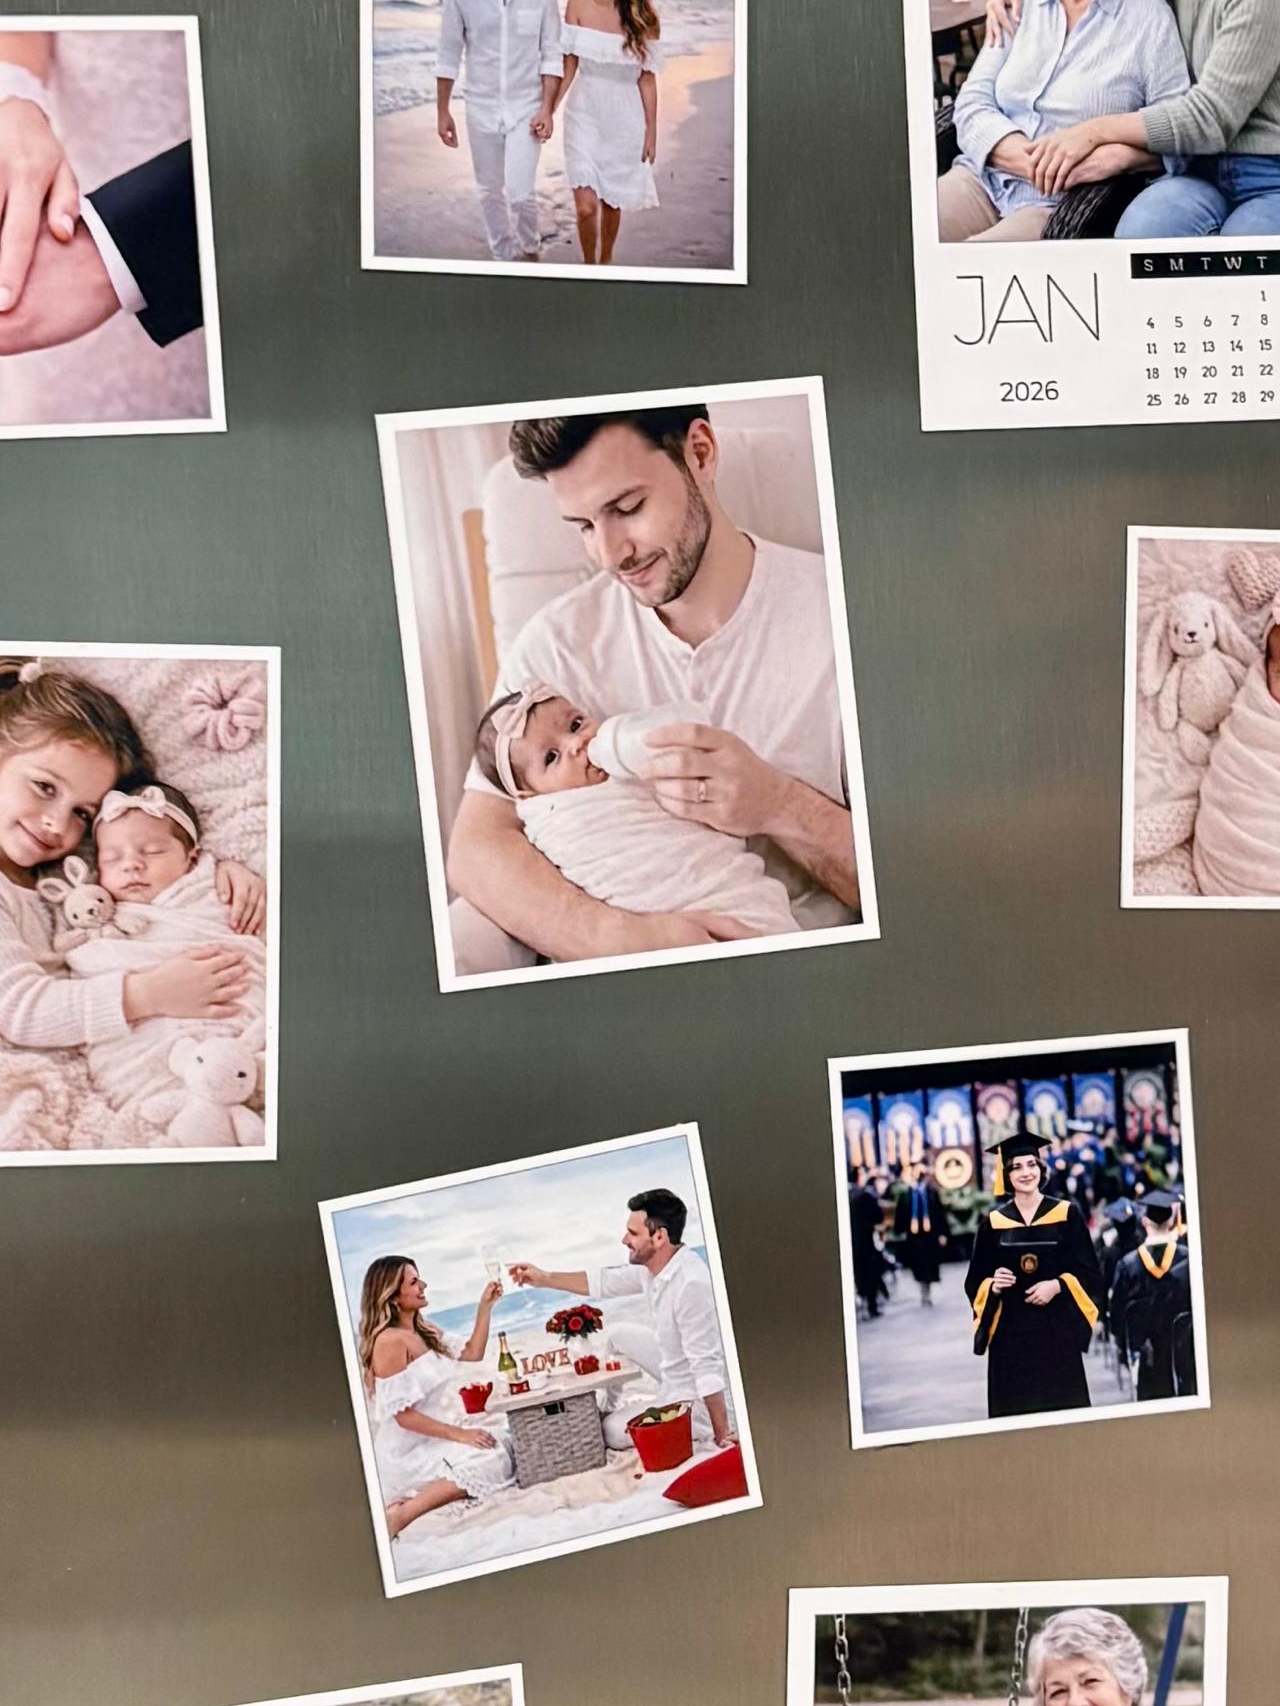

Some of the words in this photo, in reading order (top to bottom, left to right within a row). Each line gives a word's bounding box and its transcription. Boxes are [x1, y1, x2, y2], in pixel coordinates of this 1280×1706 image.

[1143, 258, 1154, 272] S
[1169, 257, 1184, 271] M
[1200, 257, 1212, 270] T
[1223, 256, 1242, 270] W
[1256, 255, 1268, 269] T
[1260, 290, 1267, 302] 1
[954, 272, 1100, 346] JAN
[1146, 317, 1155, 329] 4
[1174, 315, 1184, 329] 5
[1203, 315, 1213, 328] 6
[1230, 314, 1240, 327] 7
[1260, 313, 1269, 326] 8
[1146, 342, 1158, 355] 11
[1173, 341, 1186, 354] 12
[1202, 340, 1216, 353] 13
[1230, 339, 1243, 352] 14
[1259, 338, 1273, 351] 15
[1145, 367, 1160, 380] 18
[1174, 366, 1188, 379] 19
[1202, 365, 1218, 378] 20
[1231, 364, 1244, 377] 21
[1259, 363, 1274, 376] 22
[999, 380, 1059, 403] 2026
[1146, 393, 1162, 407] 25
[1173, 393, 1190, 406] 26
[1203, 391, 1218, 405] 27
[1231, 390, 1247, 404] 28
[1259, 390, 1275, 403] 29
[520, 1348, 571, 1375] LOVE
